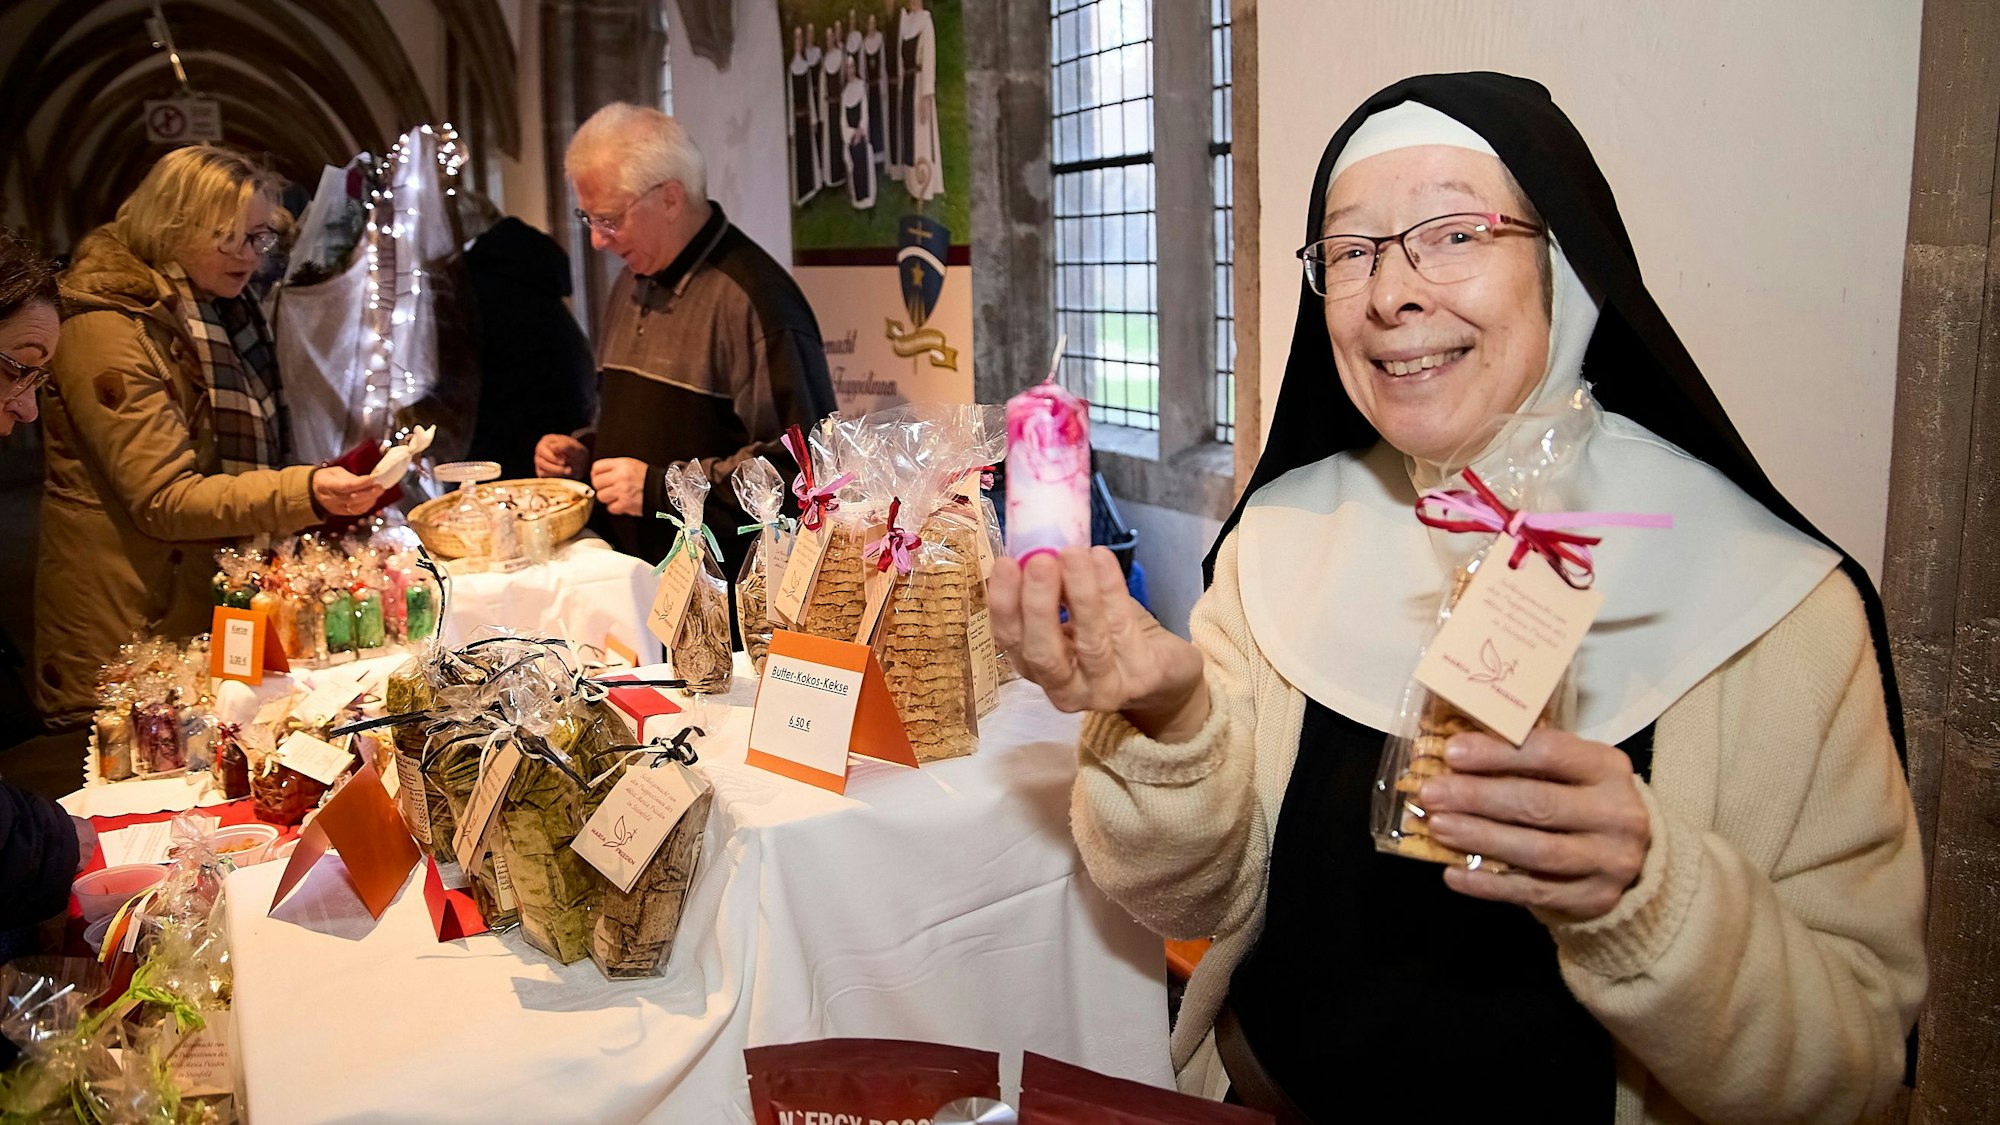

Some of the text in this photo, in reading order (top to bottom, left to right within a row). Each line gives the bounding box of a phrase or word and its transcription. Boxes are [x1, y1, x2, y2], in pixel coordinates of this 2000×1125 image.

[771, 665, 849, 695] Butter-Kokos-Kekse
[788, 715, 811, 731] 6,50 €
[591, 828, 636, 865] MARIA FRIEDEN
